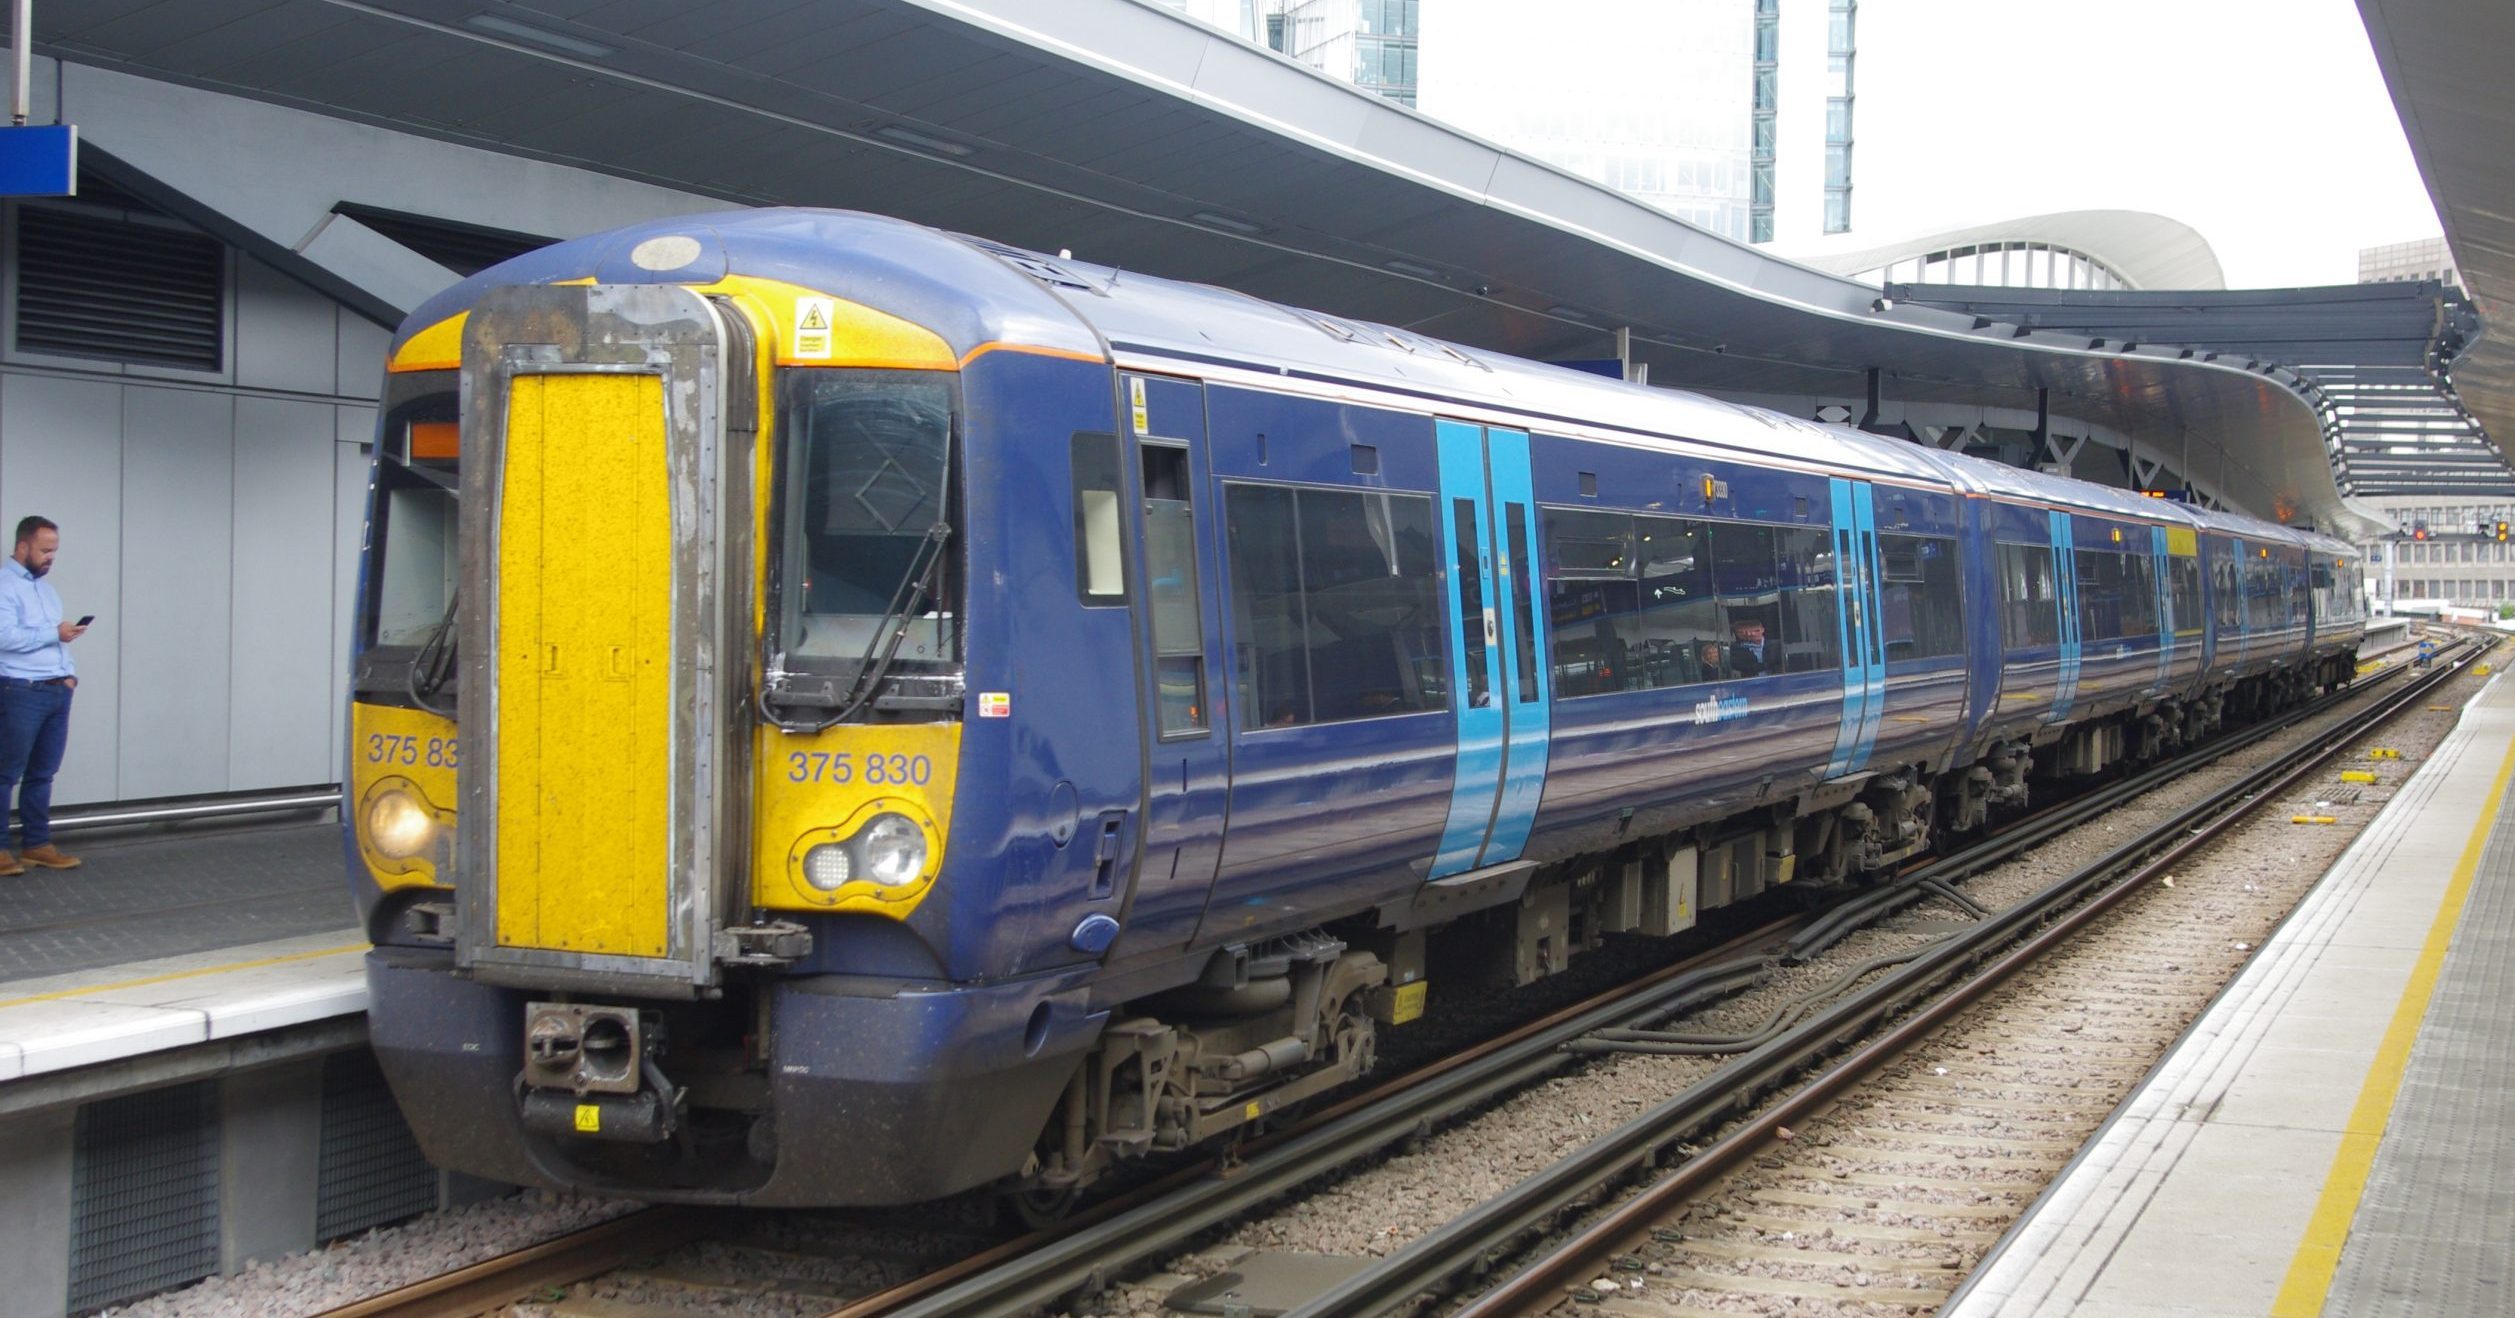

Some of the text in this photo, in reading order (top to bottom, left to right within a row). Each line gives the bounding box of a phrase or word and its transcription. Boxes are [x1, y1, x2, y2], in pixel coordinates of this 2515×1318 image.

[1695, 691, 1747, 725] southeastern
[368, 733, 458, 768] 375 83
[788, 751, 931, 786] 375 830
